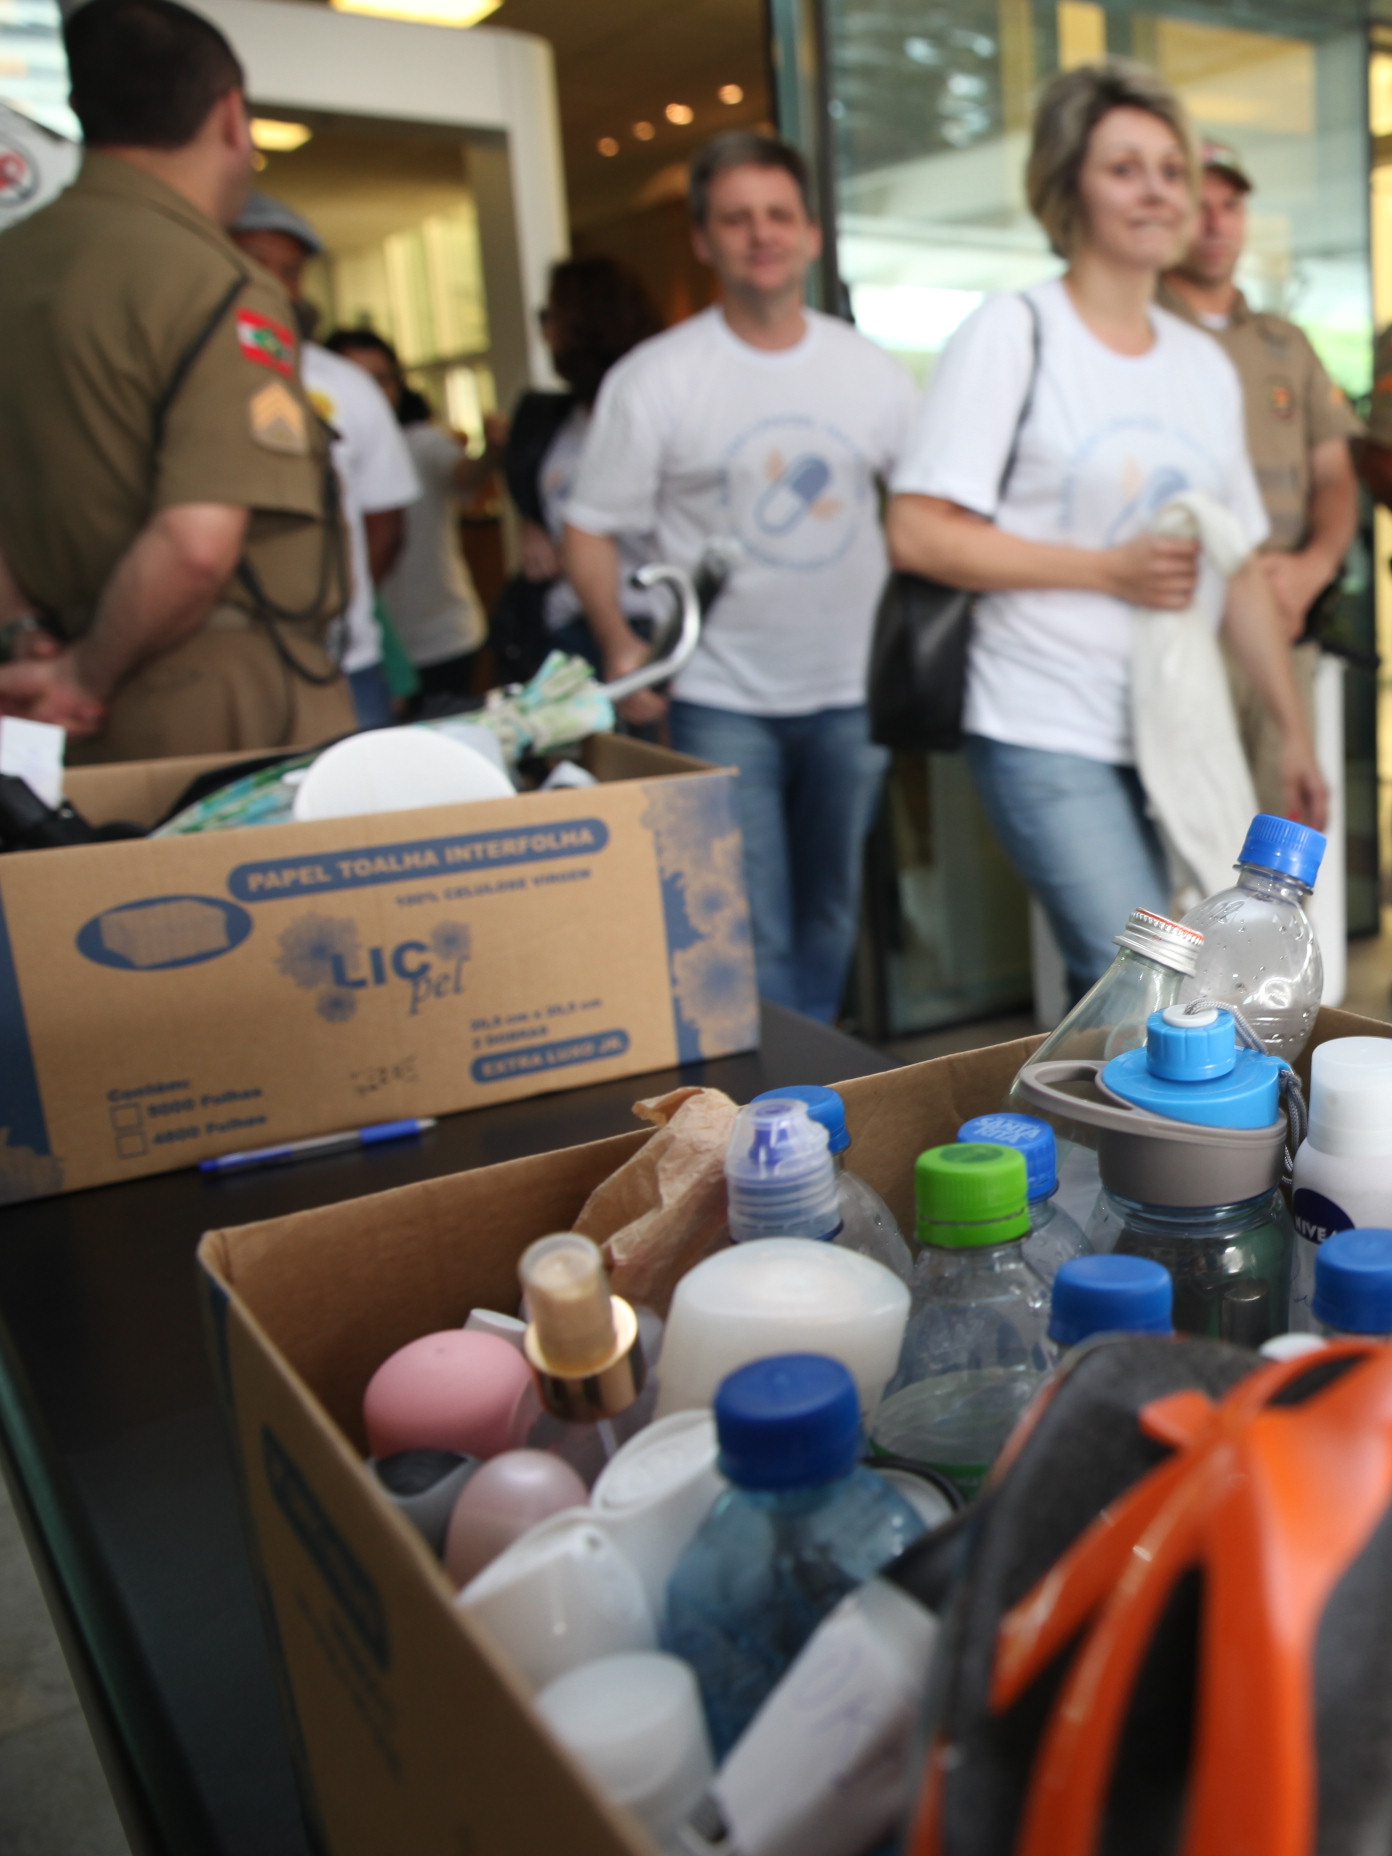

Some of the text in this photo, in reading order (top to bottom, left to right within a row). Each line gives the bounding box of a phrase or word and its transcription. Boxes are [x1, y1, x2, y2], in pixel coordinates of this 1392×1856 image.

[246, 827, 595, 892] PAPEL TOALHA INTERFOLHA
[331, 939, 431, 990] LIC
[408, 955, 471, 1017] pel
[481, 1053, 543, 1077] EXTRA
[546, 1041, 596, 1065] LUXO
[201, 1087, 263, 1108] Folhas
[206, 1115, 268, 1136] Folhas
